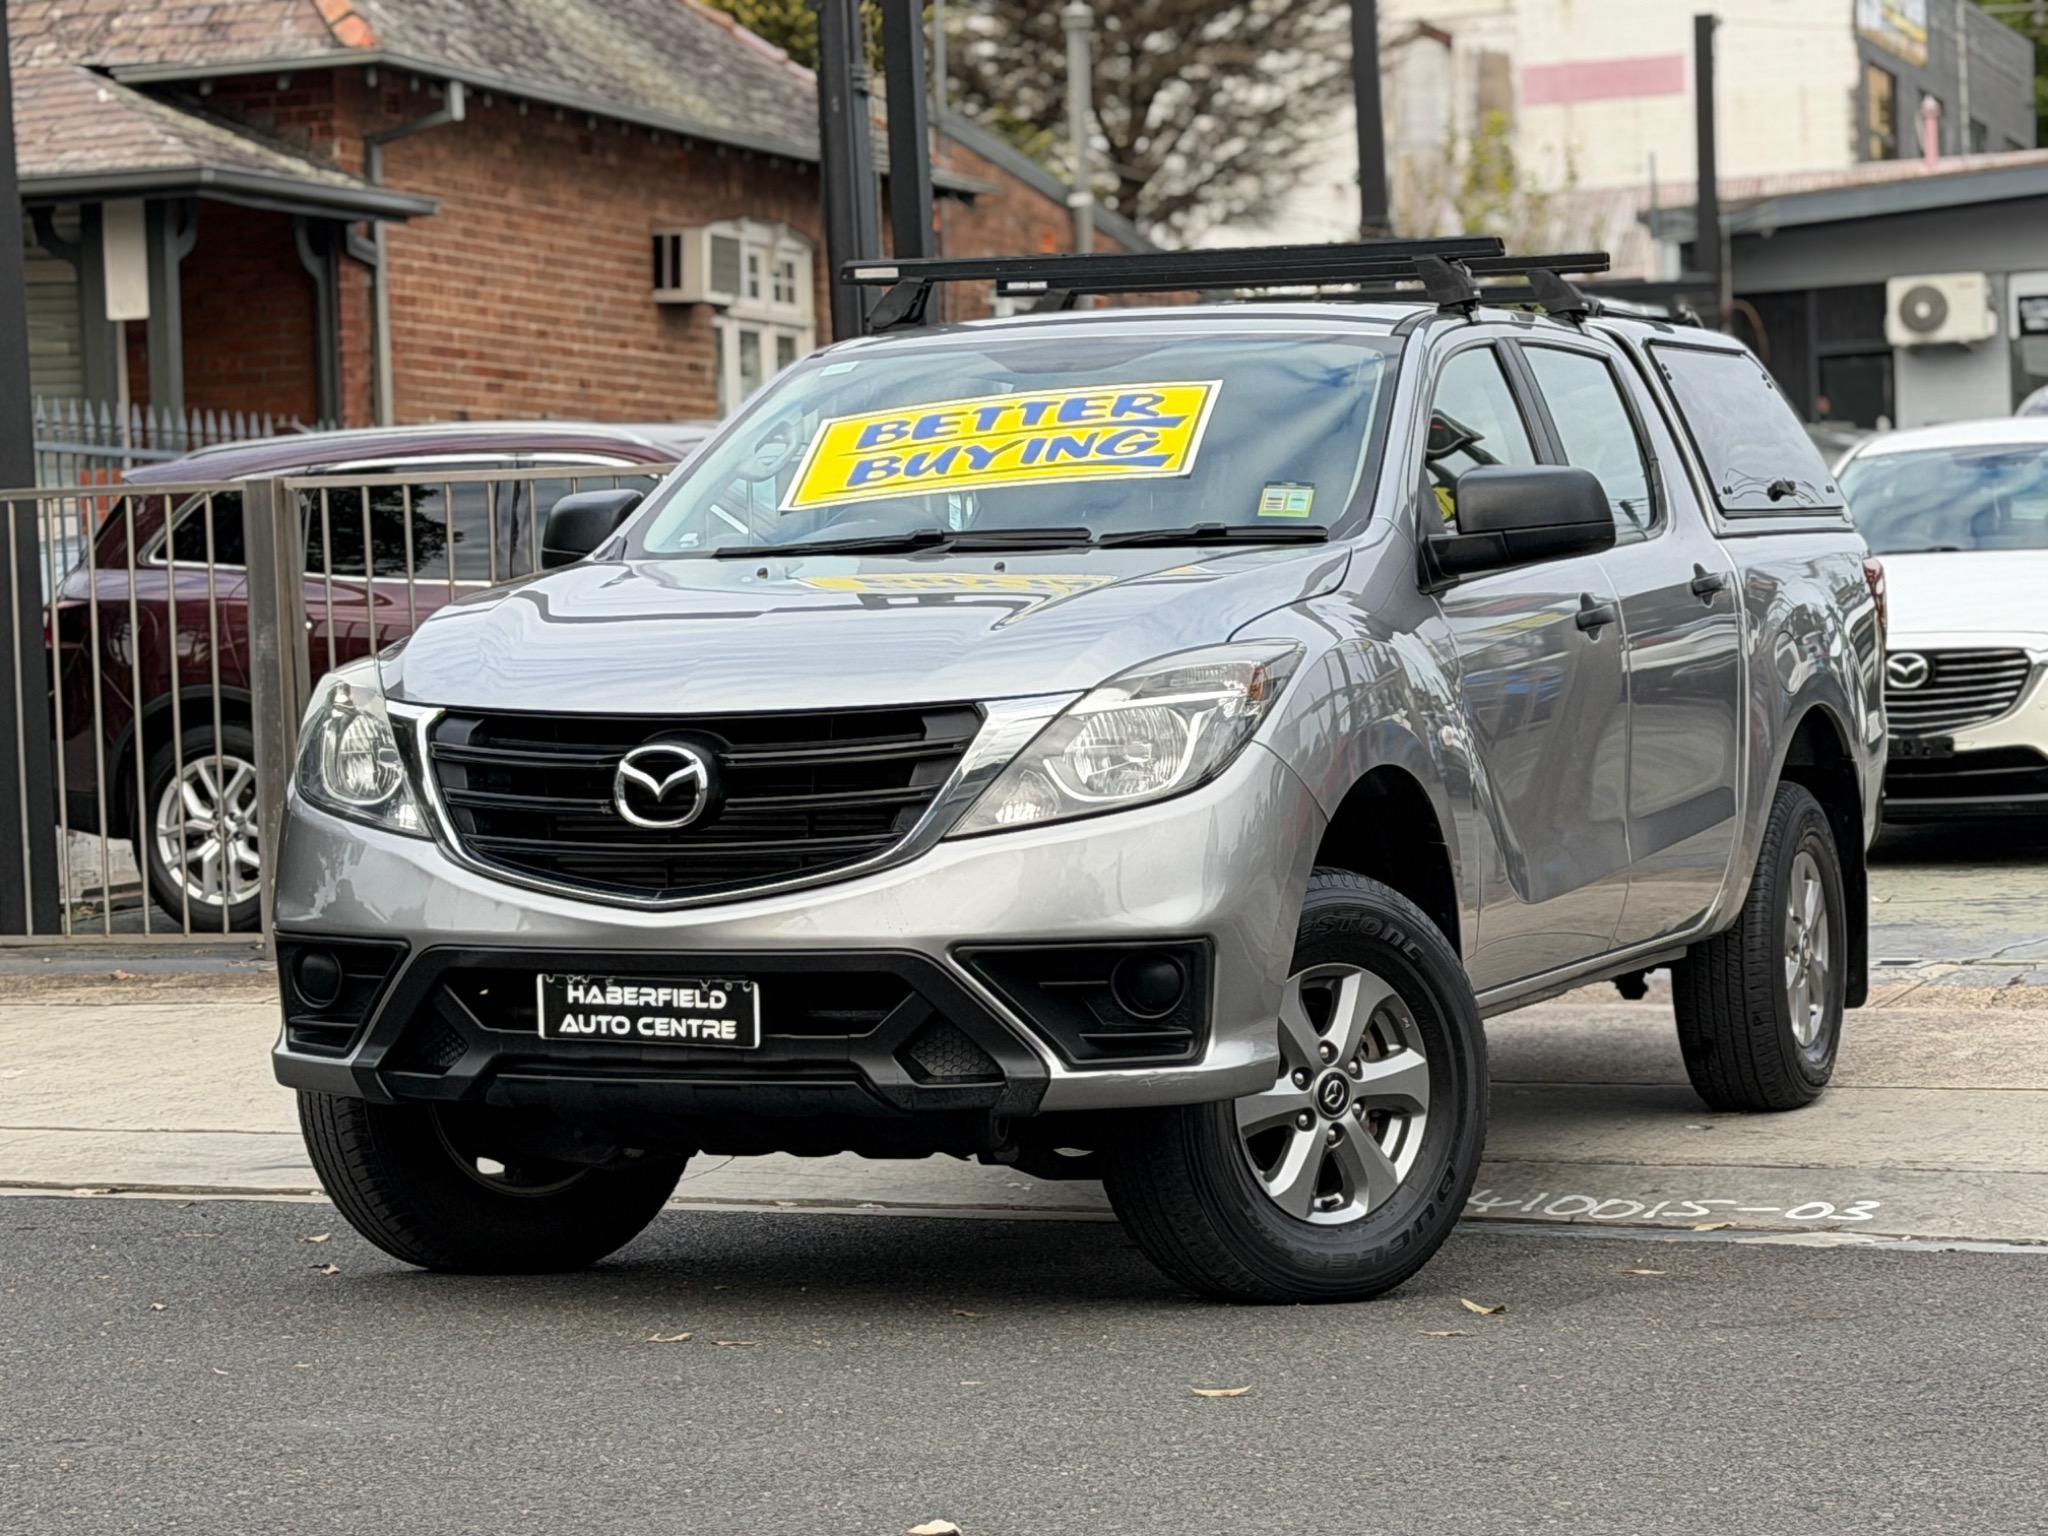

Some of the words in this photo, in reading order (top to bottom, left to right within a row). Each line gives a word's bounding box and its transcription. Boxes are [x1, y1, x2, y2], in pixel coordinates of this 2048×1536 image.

[854, 393, 1166, 450] BETTER
[846, 428, 1162, 488] BUYING
[567, 984, 727, 1010] HABERFIELD
[559, 1013, 631, 1035] AUTO
[637, 1016, 737, 1040] CENTRE
